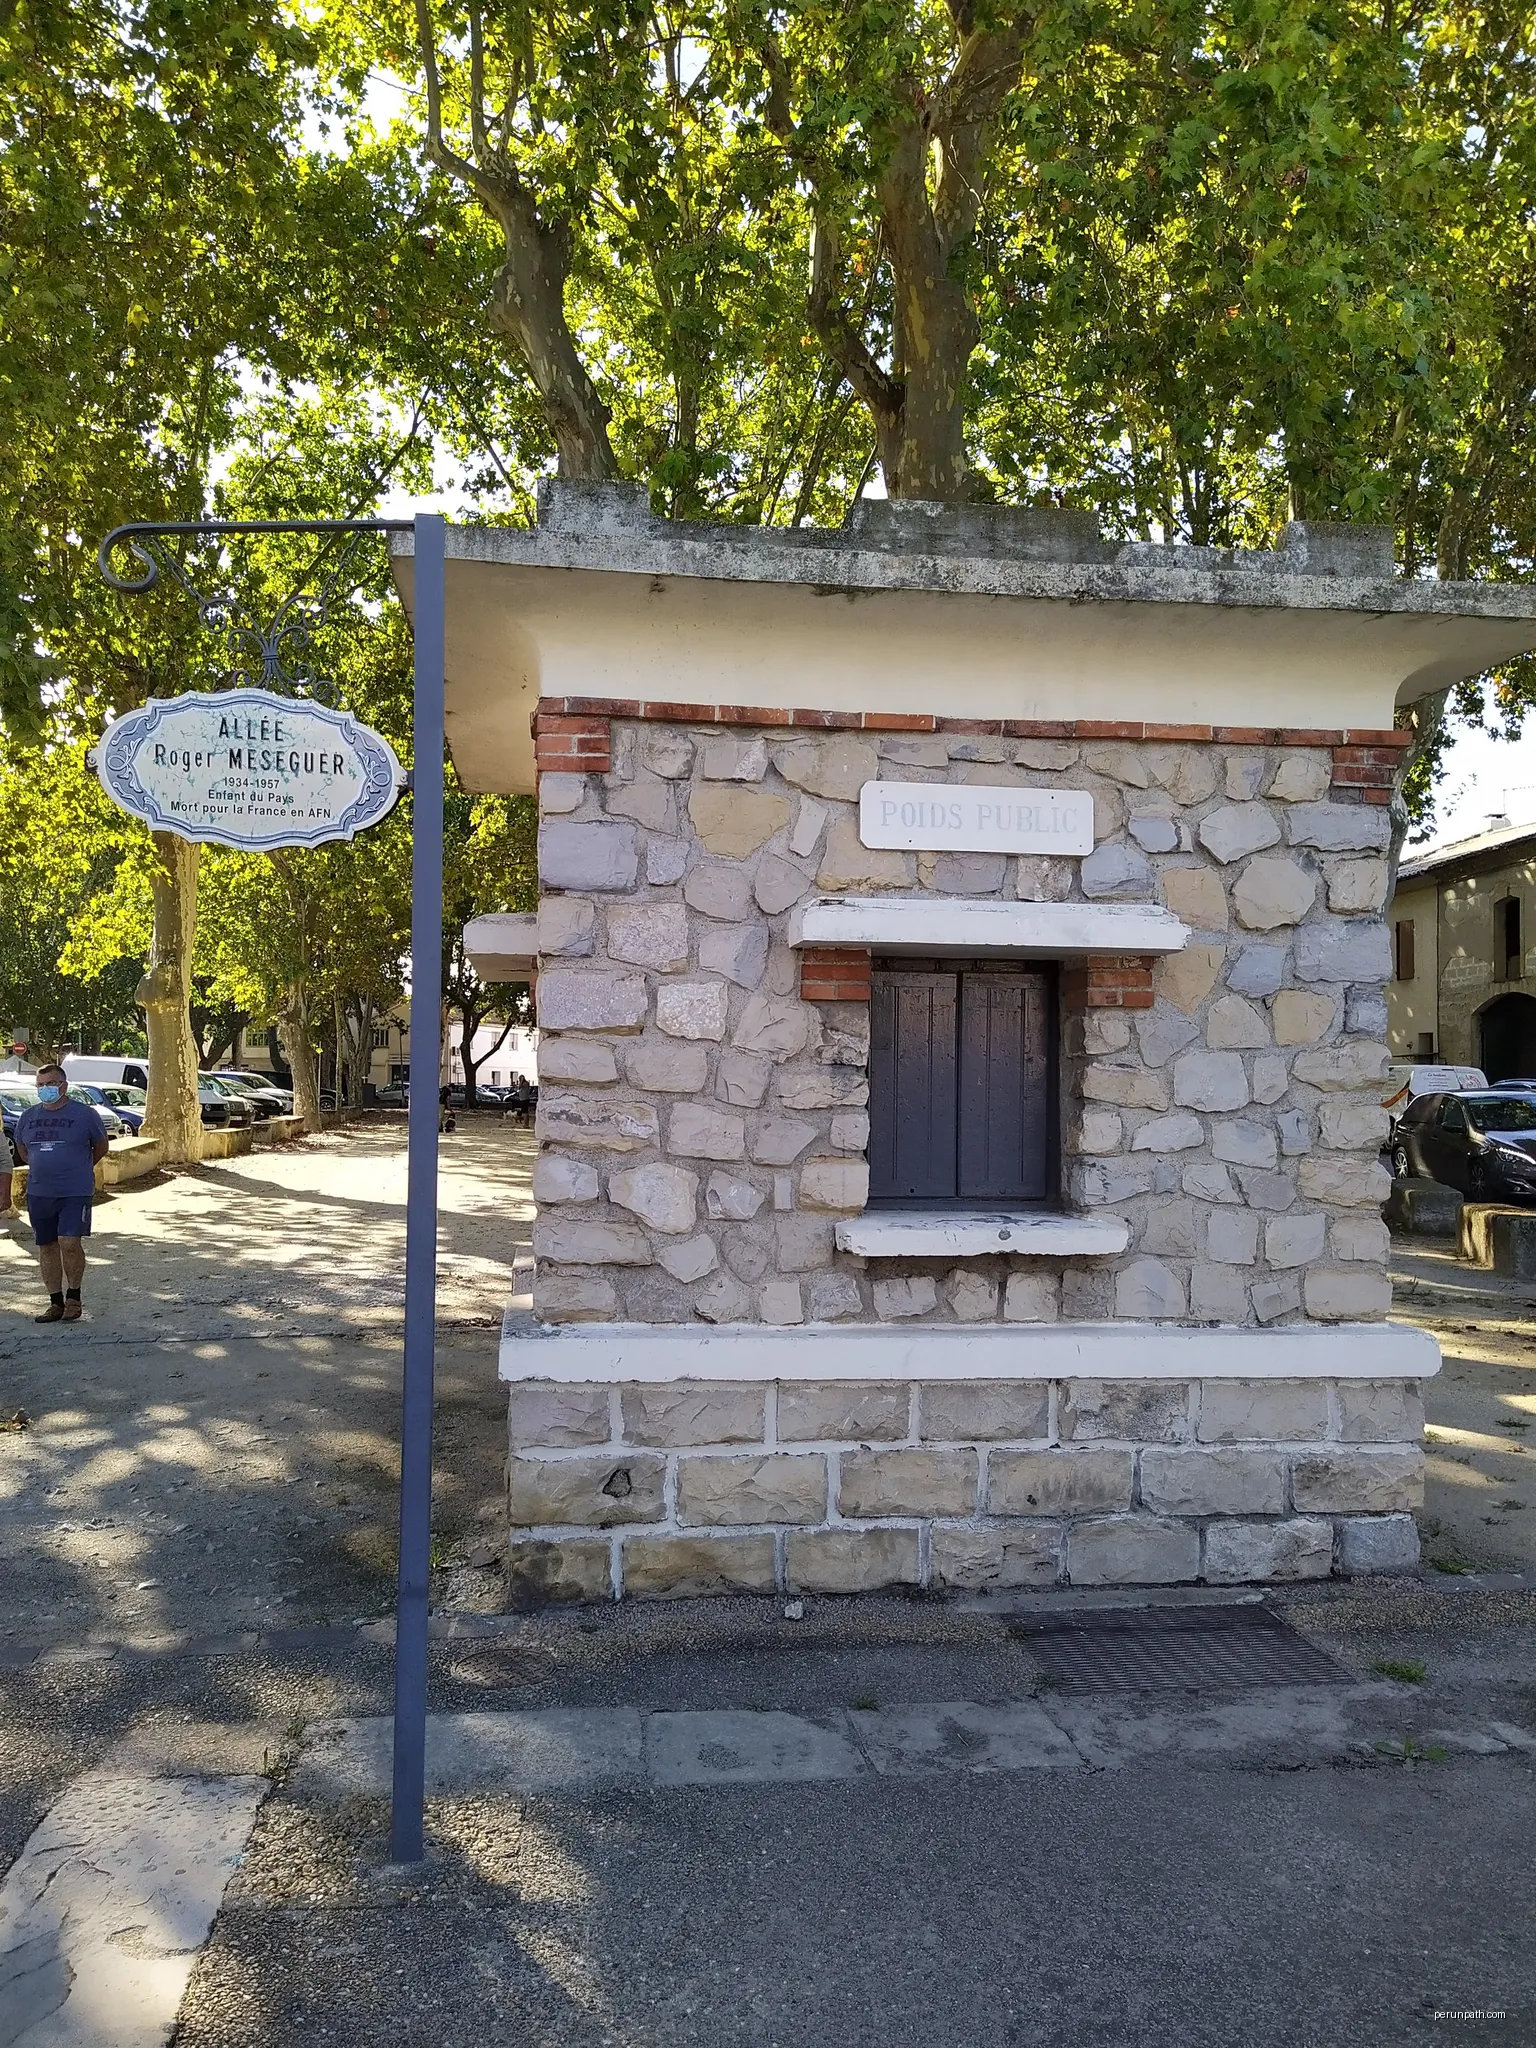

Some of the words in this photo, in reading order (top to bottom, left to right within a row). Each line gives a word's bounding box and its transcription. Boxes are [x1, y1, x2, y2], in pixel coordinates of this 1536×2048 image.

[218, 715, 284, 741] ALLÉE
[154, 743, 212, 772] Roger
[229, 748, 344, 775] MESEGUER
[224, 776, 280, 789] 1934-1957
[208, 789, 245, 801] Enfant
[250, 791, 264, 802] du
[268, 792, 295, 805] Pays
[170, 800, 198, 812] Mort
[203, 805, 229, 815] pour
[233, 804, 243, 814] la
[248, 804, 287, 816] France
[291, 809, 304, 817] en
[308, 808, 331, 819] AFN
[880, 800, 962, 830] POIDS
[976, 804, 1078, 833] PUBLIC
